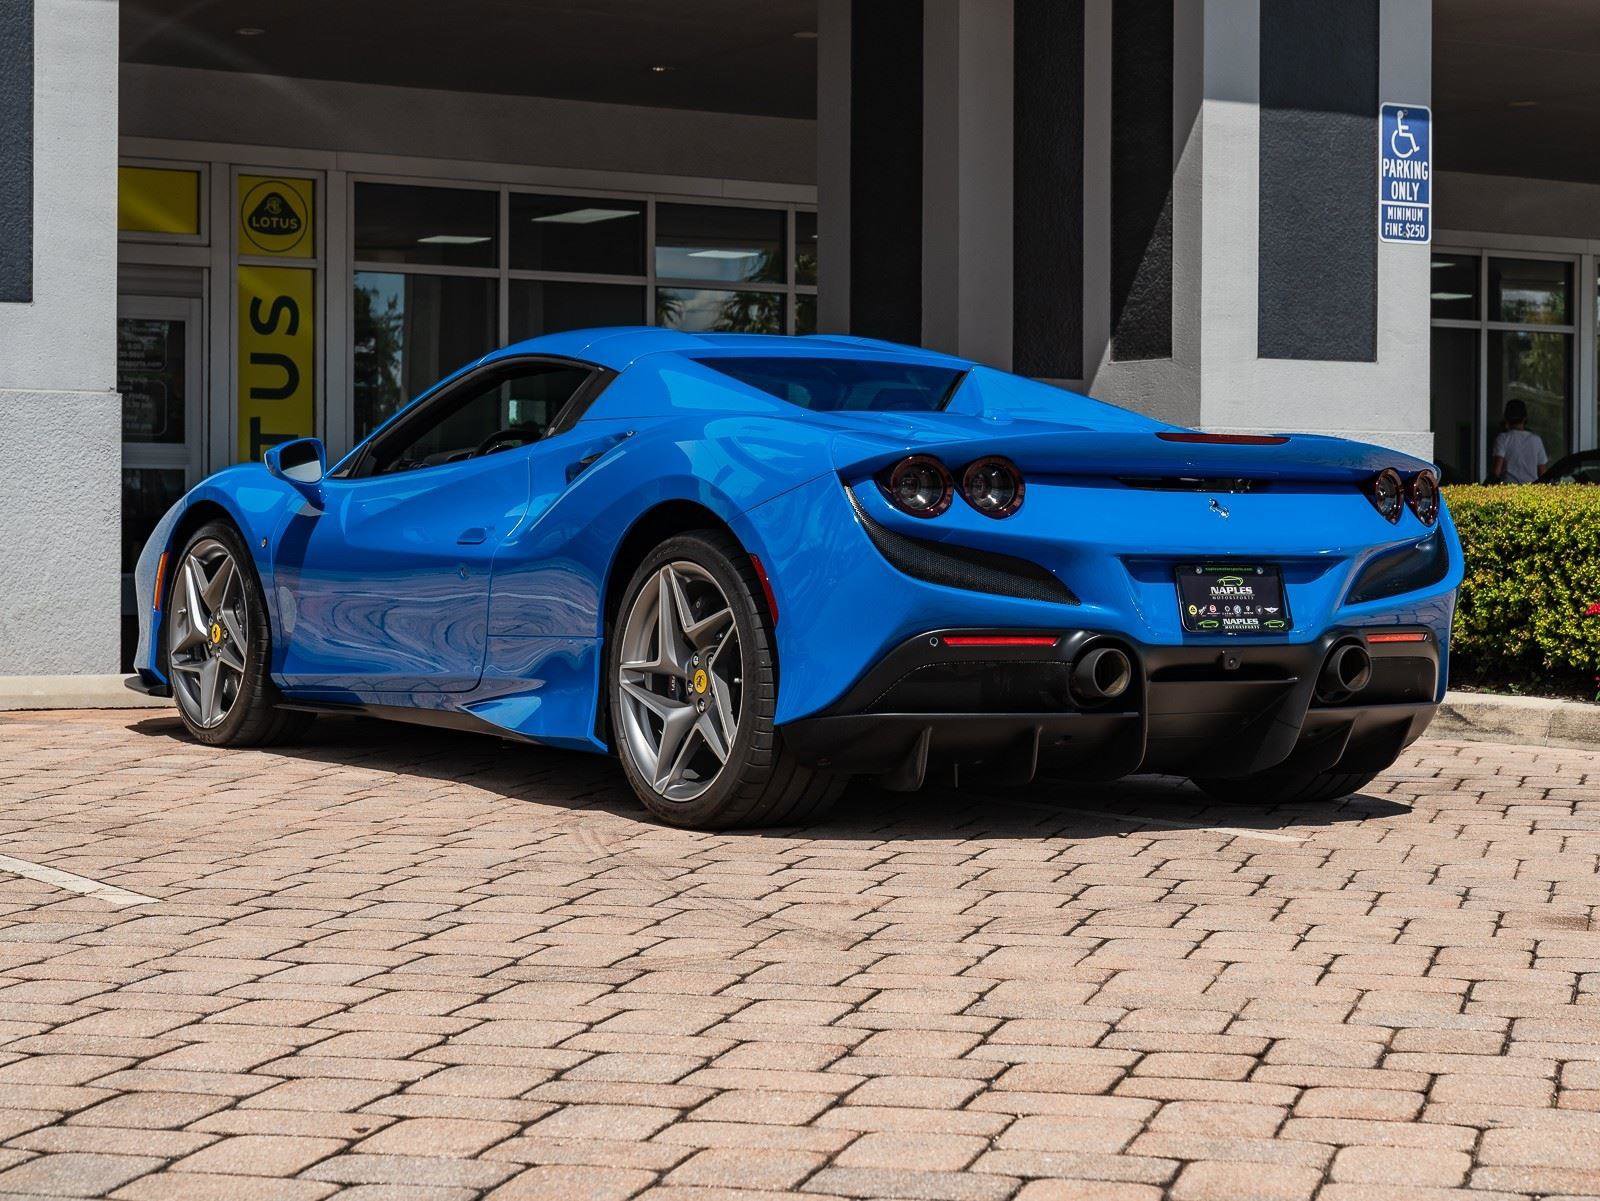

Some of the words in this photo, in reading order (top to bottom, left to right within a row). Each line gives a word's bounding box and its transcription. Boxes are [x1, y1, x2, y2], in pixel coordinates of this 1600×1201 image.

[1383, 159, 1428, 180] PARKING
[1391, 181, 1420, 201] ONLY
[1387, 207, 1423, 221] MINIMUM
[252, 216, 298, 229] LOTUS
[1385, 222, 1403, 235] FINE
[1405, 223, 1426, 238] $250
[250, 295, 299, 462] TUS
[1210, 586, 1253, 595] NAPLES
